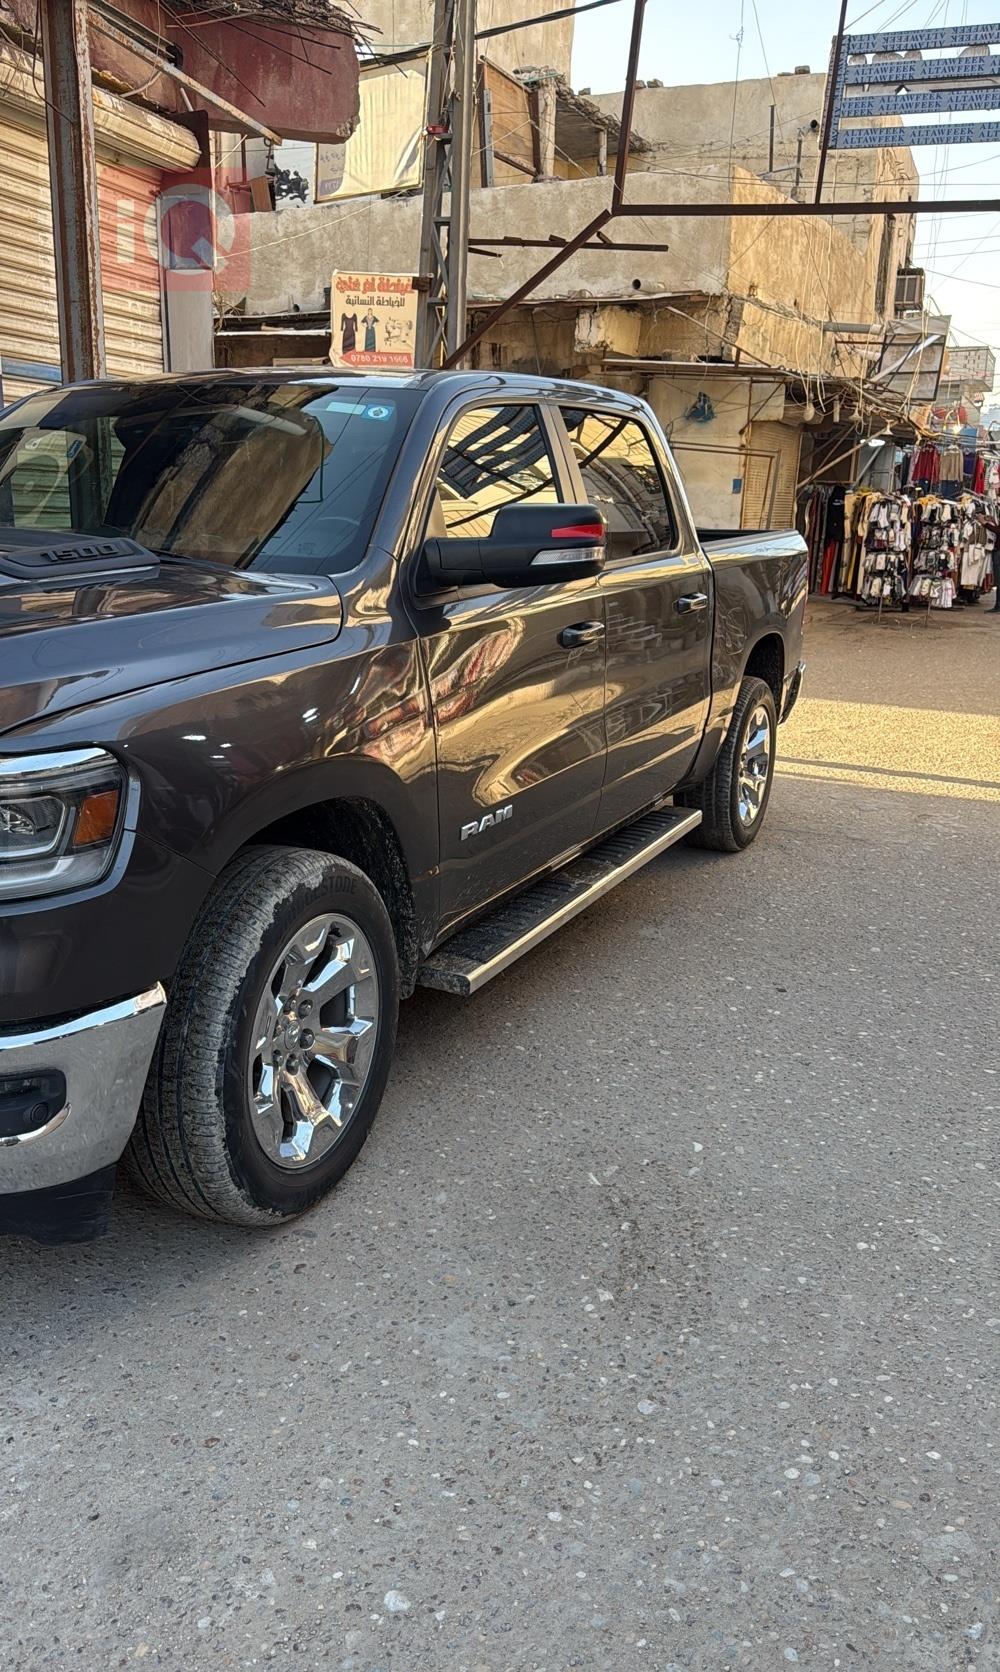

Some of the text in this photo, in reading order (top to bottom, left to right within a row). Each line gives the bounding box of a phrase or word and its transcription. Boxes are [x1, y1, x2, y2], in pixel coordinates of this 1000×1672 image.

[882, 32, 945, 44] ALTAWFEEK
[922, 57, 985, 67] ALTAWFEEK
[855, 65, 915, 76] ALTAWFEEK
[920, 64, 984, 75] ALTAWFEEK
[879, 93, 943, 104] ALTAWFEEK
[878, 101, 942, 111] ALTAWFEEK
[911, 128, 974, 138] ALTAWFEEK
[843, 135, 904, 145] ALTAWFEEK
[376, 296, 405, 308] للخياطة
[40, 543, 118, 562] 1500
[461, 804, 513, 841] RAM
